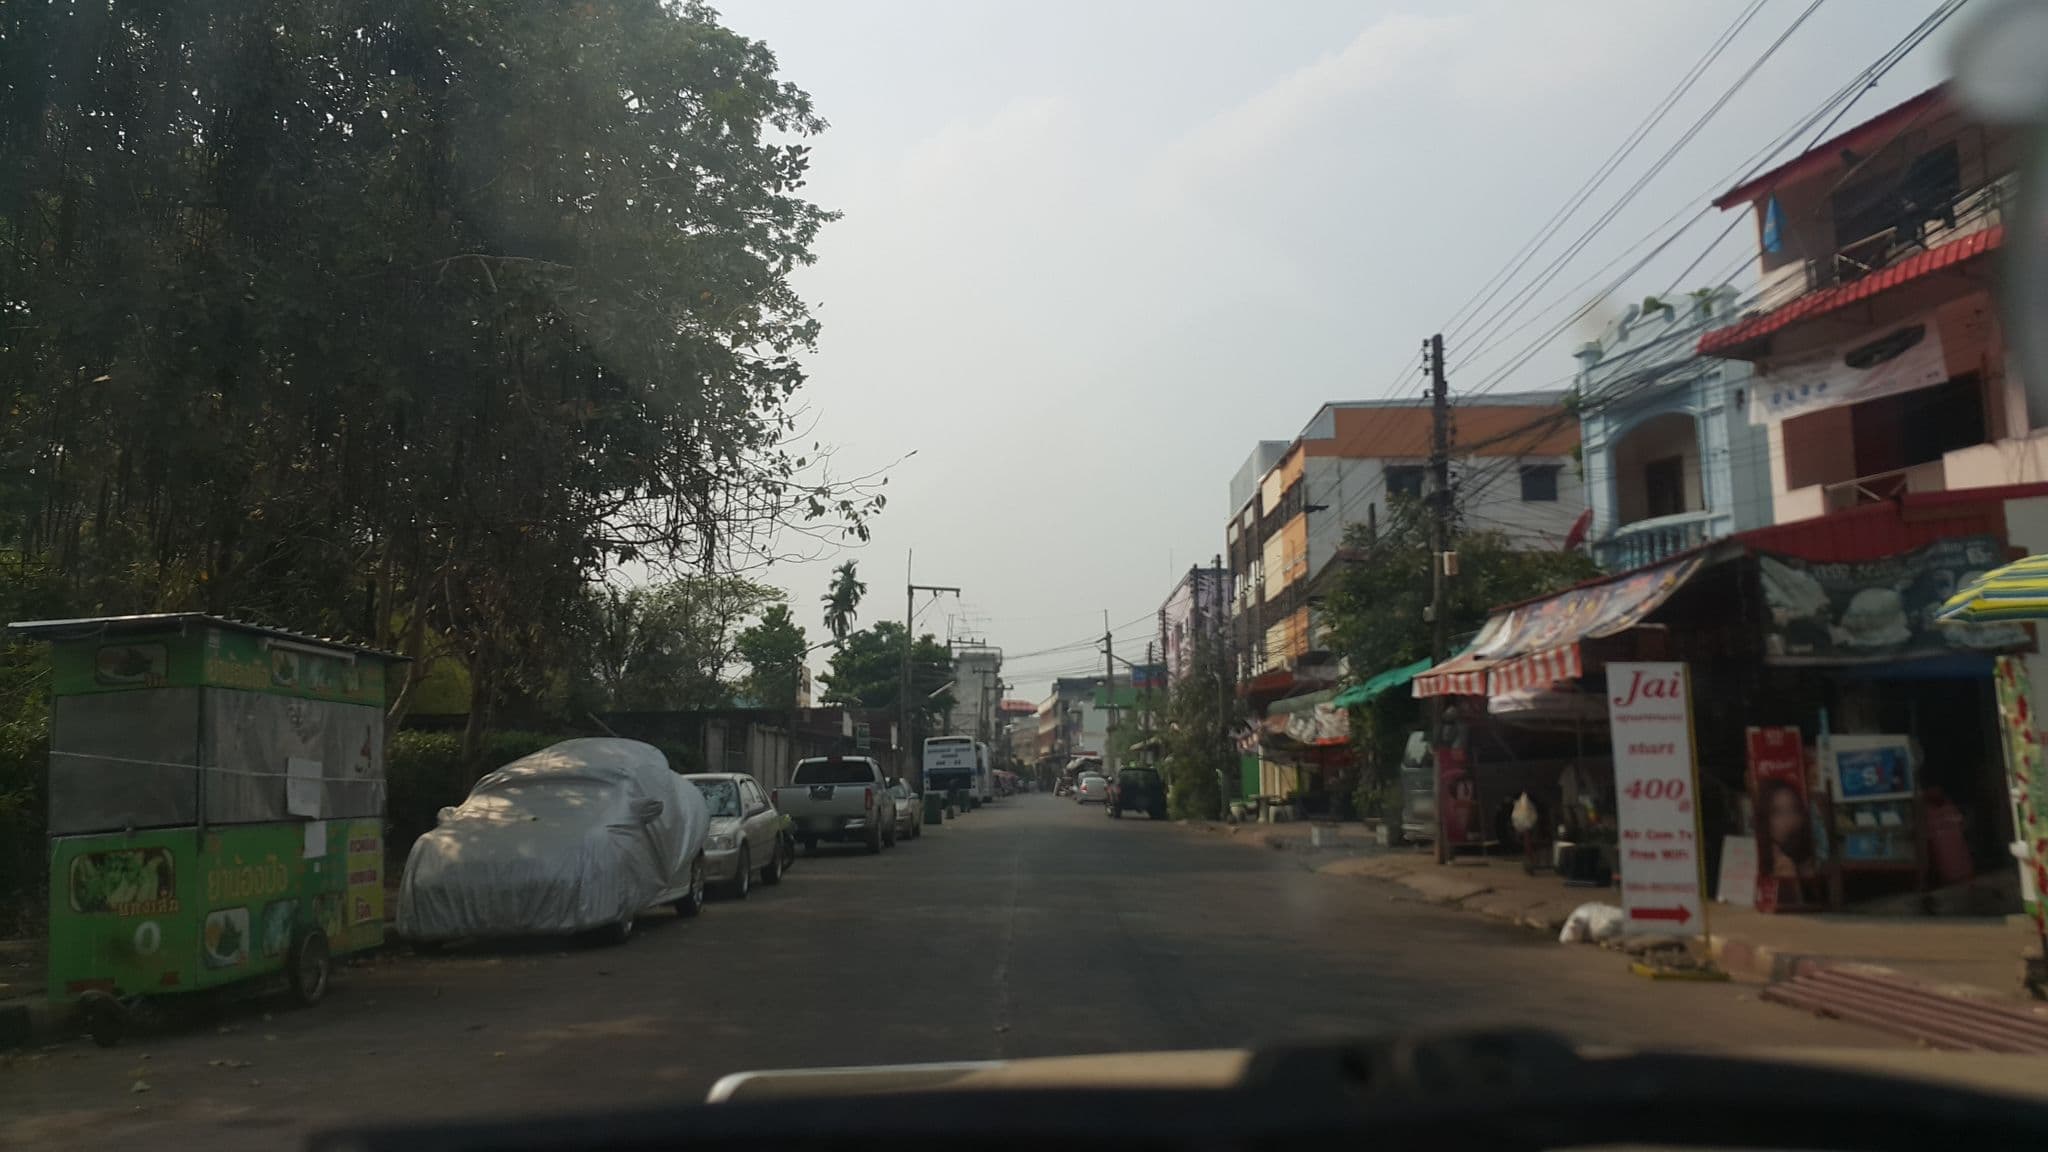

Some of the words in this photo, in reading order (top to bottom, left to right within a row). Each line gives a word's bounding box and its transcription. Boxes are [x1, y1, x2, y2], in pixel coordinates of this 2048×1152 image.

[1613, 670, 1681, 707] Jai
[1628, 742, 1675, 756] start
[1624, 779, 1685, 800] 400
